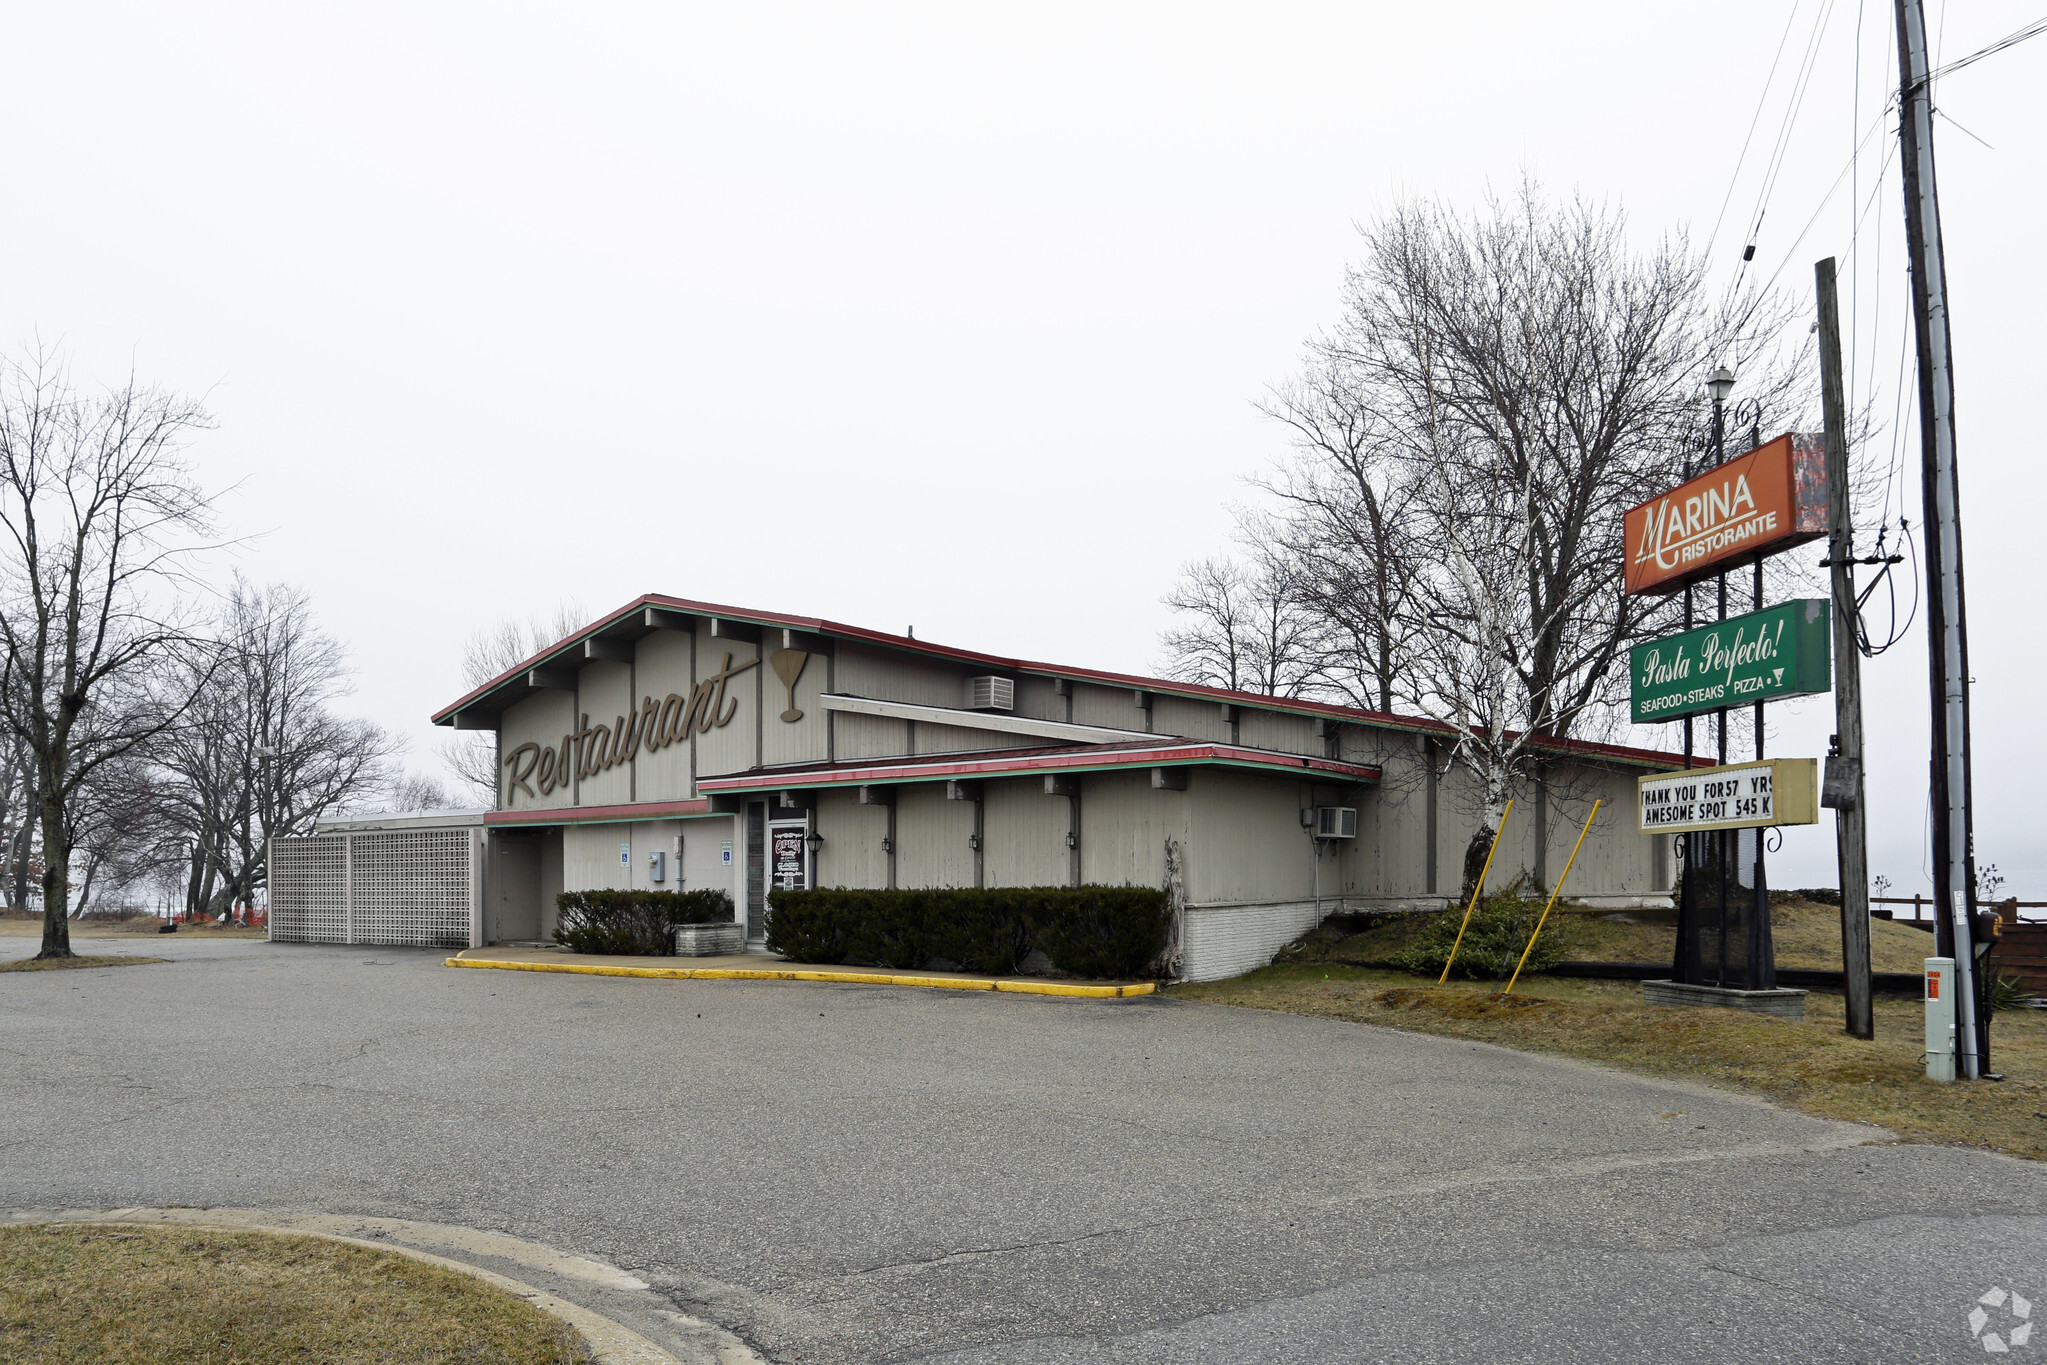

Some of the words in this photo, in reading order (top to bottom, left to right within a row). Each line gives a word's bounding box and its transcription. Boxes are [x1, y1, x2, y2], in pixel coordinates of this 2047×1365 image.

[1635, 474, 1757, 569] MARINA
[1682, 511, 1777, 563] RISTORANTE
[1642, 645, 1691, 688] Pasta
[1699, 619, 1784, 686] Perfecto!
[1734, 676, 1764, 695] PIZZA
[503, 652, 762, 806] Restaurant
[1645, 804, 1694, 824] AWESOME
[1699, 801, 1727, 819] SPOT
[1736, 798, 1757, 816] 545
[1762, 796, 1771, 814] K
[1675, 785, 1696, 802] YOU
[1704, 782, 1724, 799] FOR
[1726, 780, 1739, 797] 57
[775, 839, 801, 855] OPEN
